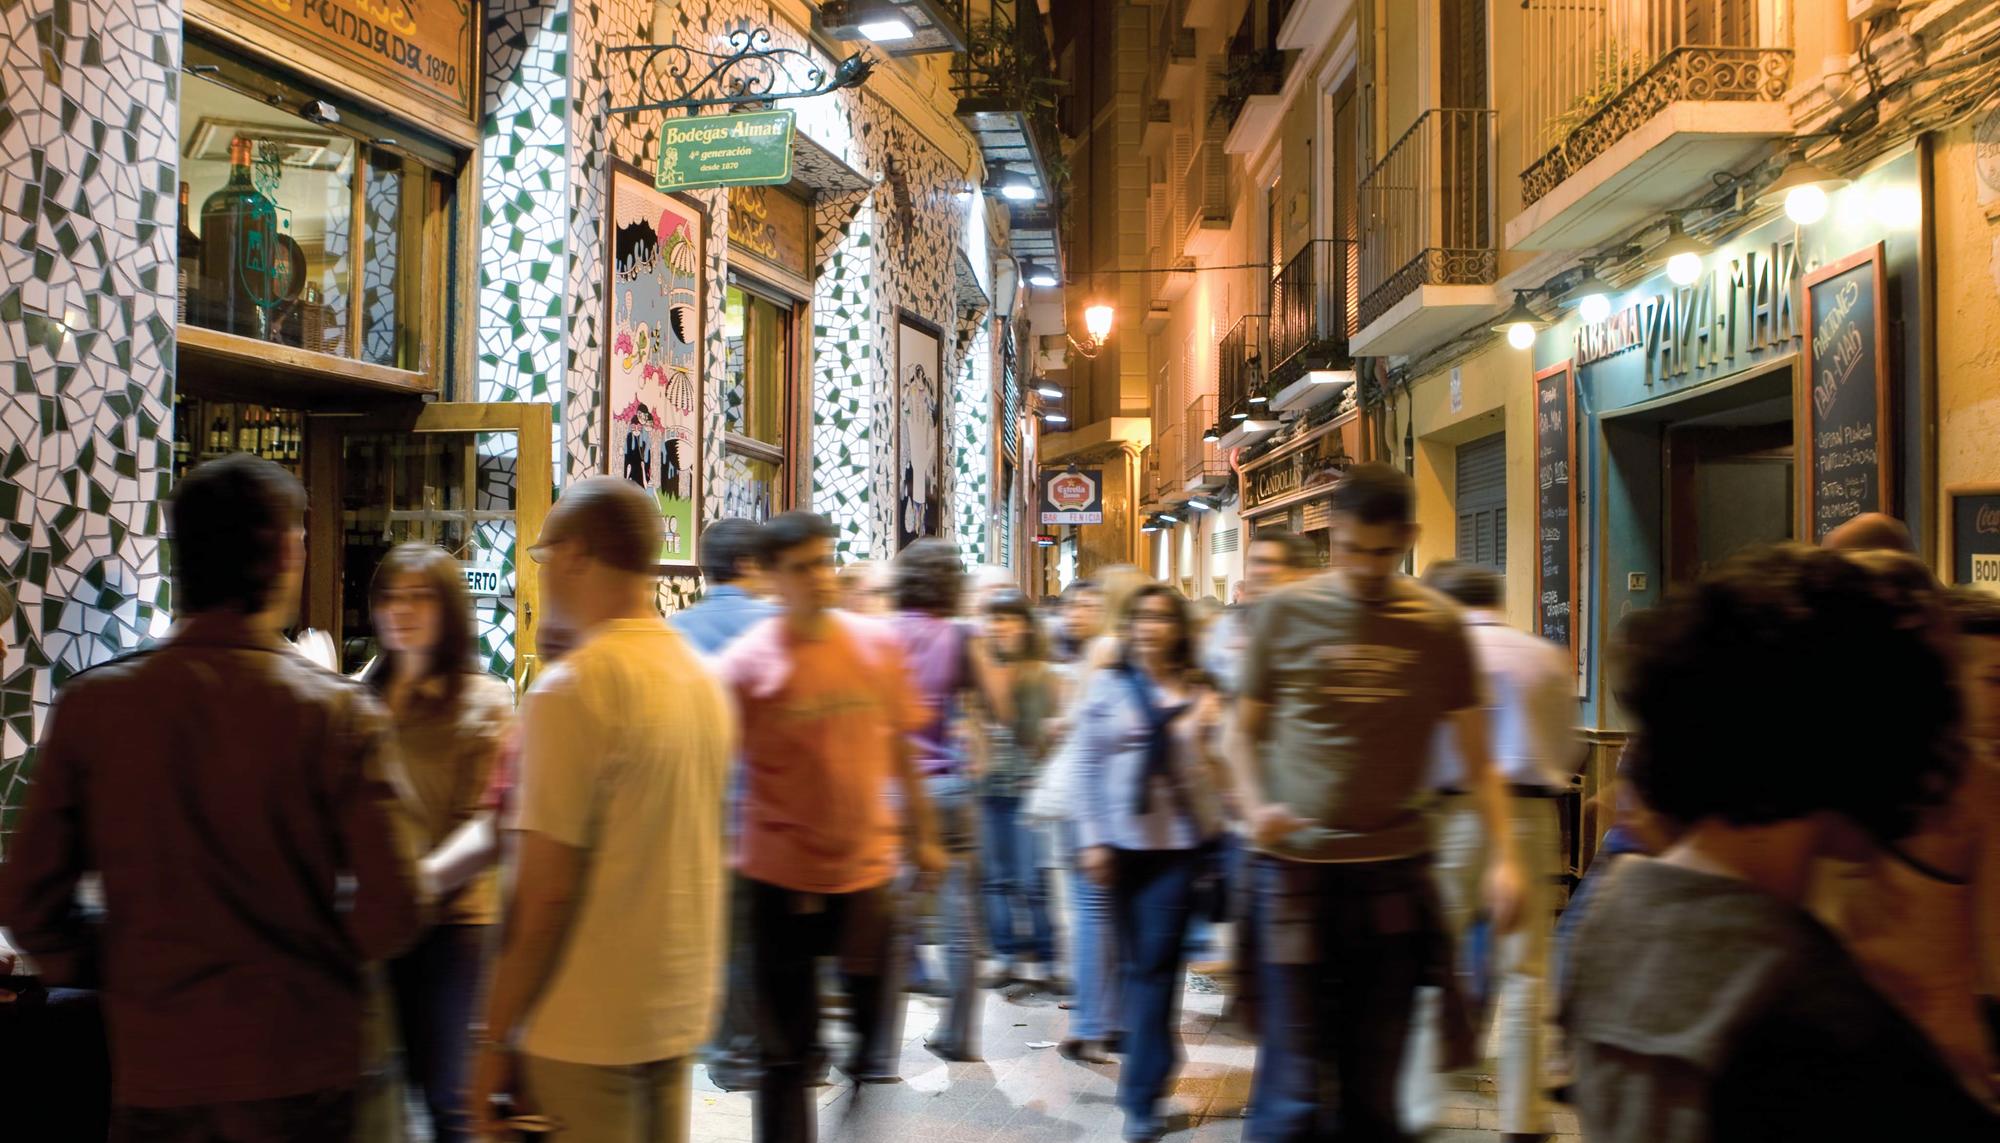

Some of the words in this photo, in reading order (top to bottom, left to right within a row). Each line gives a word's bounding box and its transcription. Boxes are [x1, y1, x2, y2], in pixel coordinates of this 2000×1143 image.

[426, 53, 456, 87] 1870
[666, 126, 728, 145] Bodegas
[701, 147, 752, 161] generación
[700, 163, 721, 172] desde
[722, 162, 739, 171] 1870
[1043, 513, 1056, 522] BAR
[1070, 512, 1101, 522] FENICIA
[1975, 560, 2000, 582] BOD
[467, 571, 497, 591] ERTO
